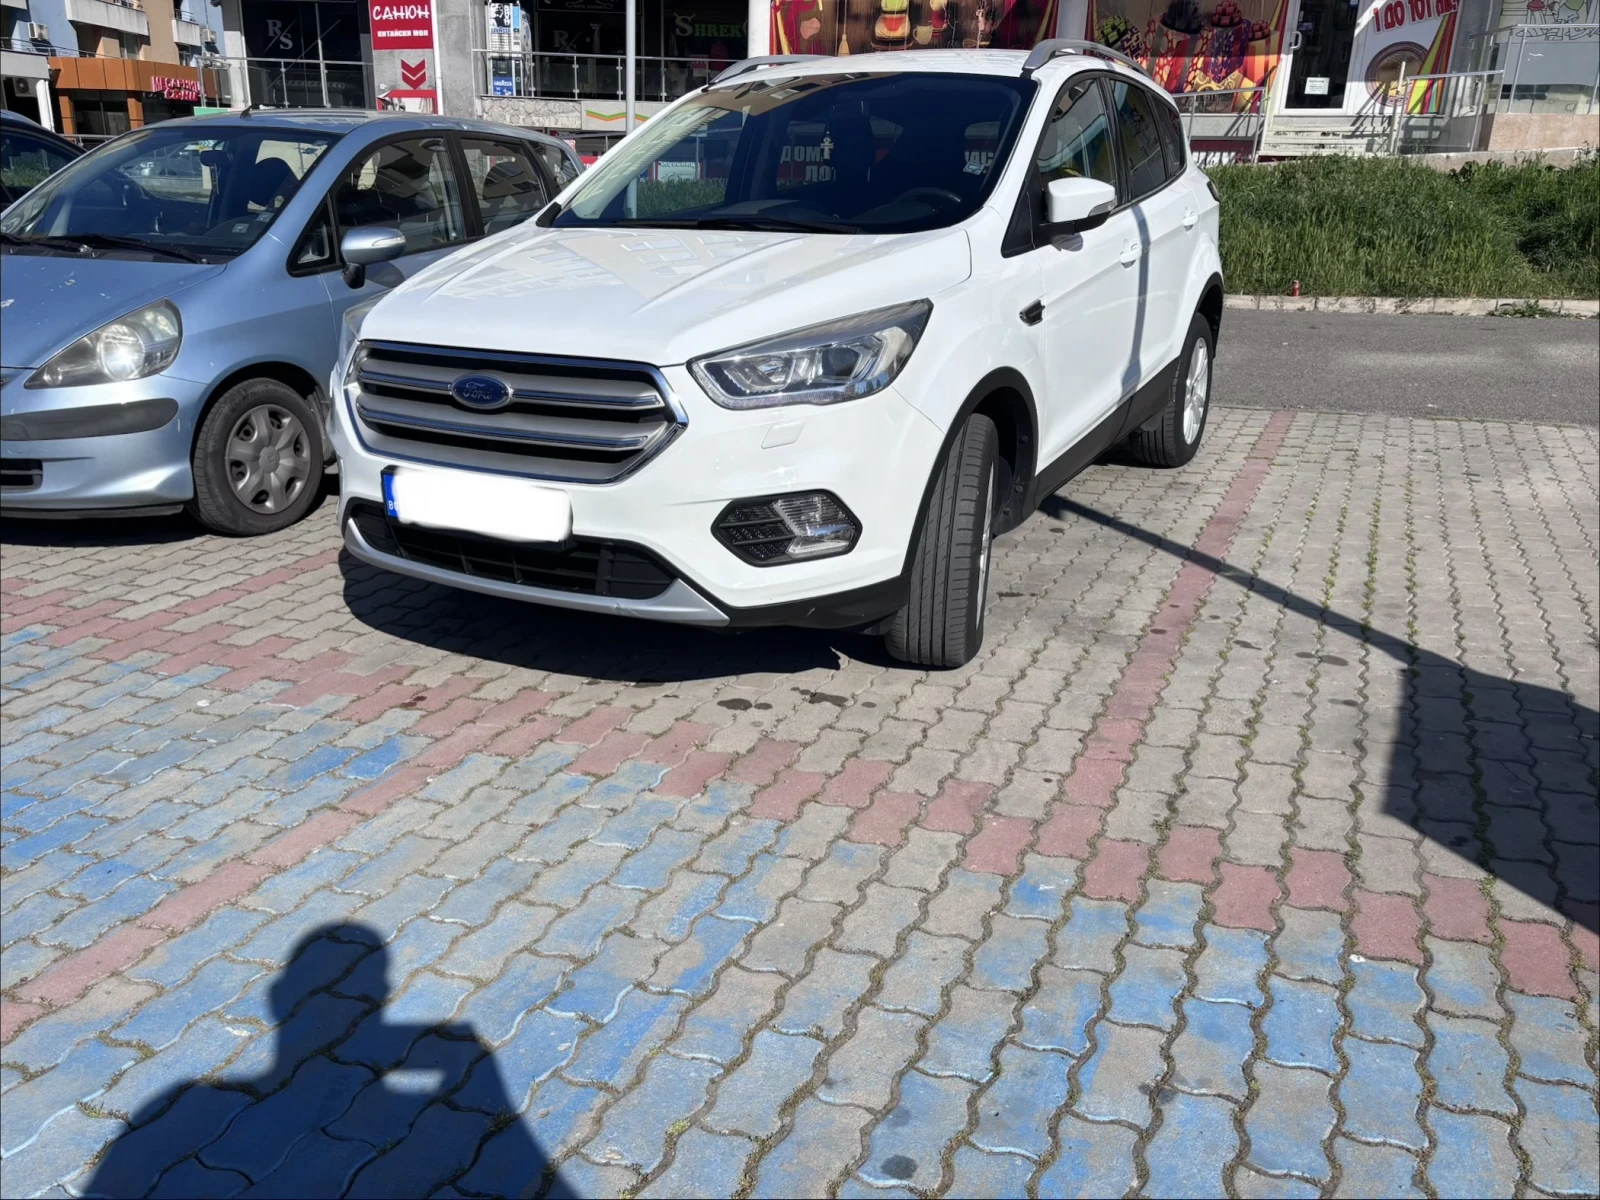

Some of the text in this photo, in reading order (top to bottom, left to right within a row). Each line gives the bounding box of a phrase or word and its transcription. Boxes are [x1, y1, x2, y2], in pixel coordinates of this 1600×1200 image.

[372, 4, 430, 20] САНЮН
[377, 29, 412, 37] КИТАЙСКИ
[463, 381, 493, 400] Ford
